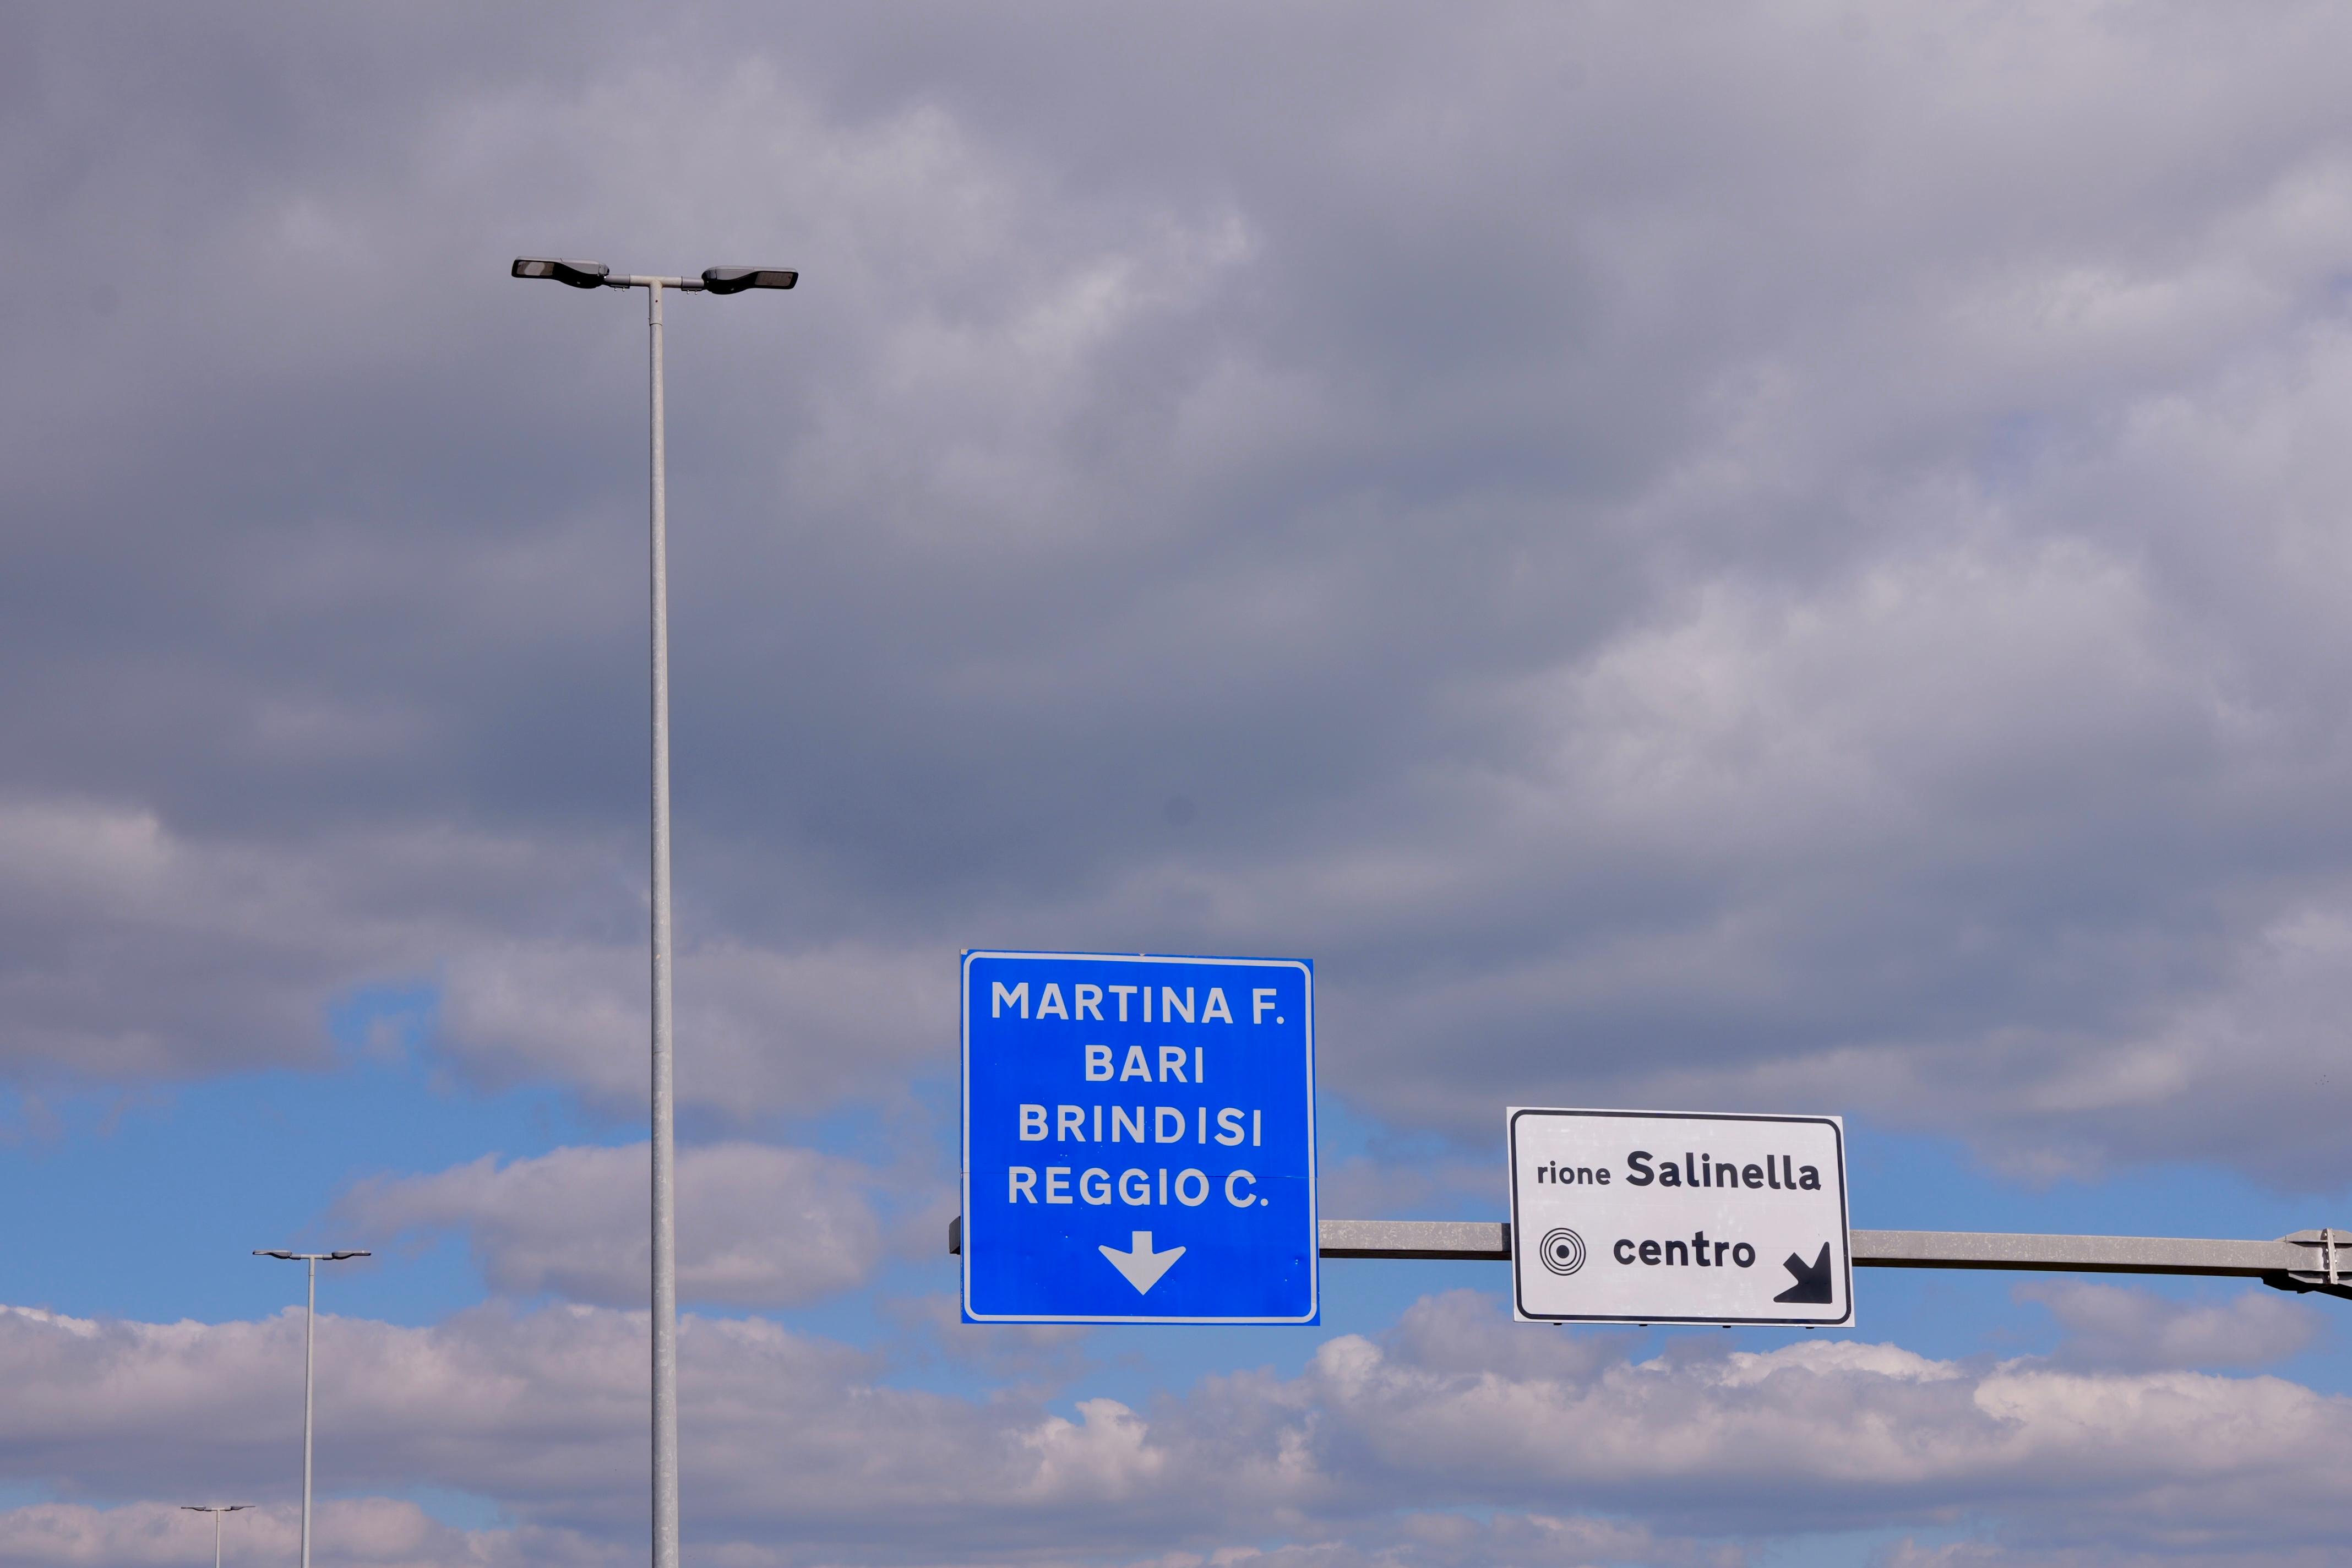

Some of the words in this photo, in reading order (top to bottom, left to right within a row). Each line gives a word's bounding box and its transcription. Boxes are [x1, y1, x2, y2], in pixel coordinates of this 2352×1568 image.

[992, 981, 1233, 1024] MARTINA
[1252, 988, 1285, 1025] F.
[1085, 1044, 1204, 1084] BARI
[1019, 1103, 1261, 1147] BRINDISI
[1008, 1166, 1209, 1207] REGGIO
[1224, 1169, 1268, 1208] C.
[1537, 1161, 1611, 1185] rione
[1625, 1150, 1821, 1191] Salinella
[1614, 1231, 1756, 1268] centro
